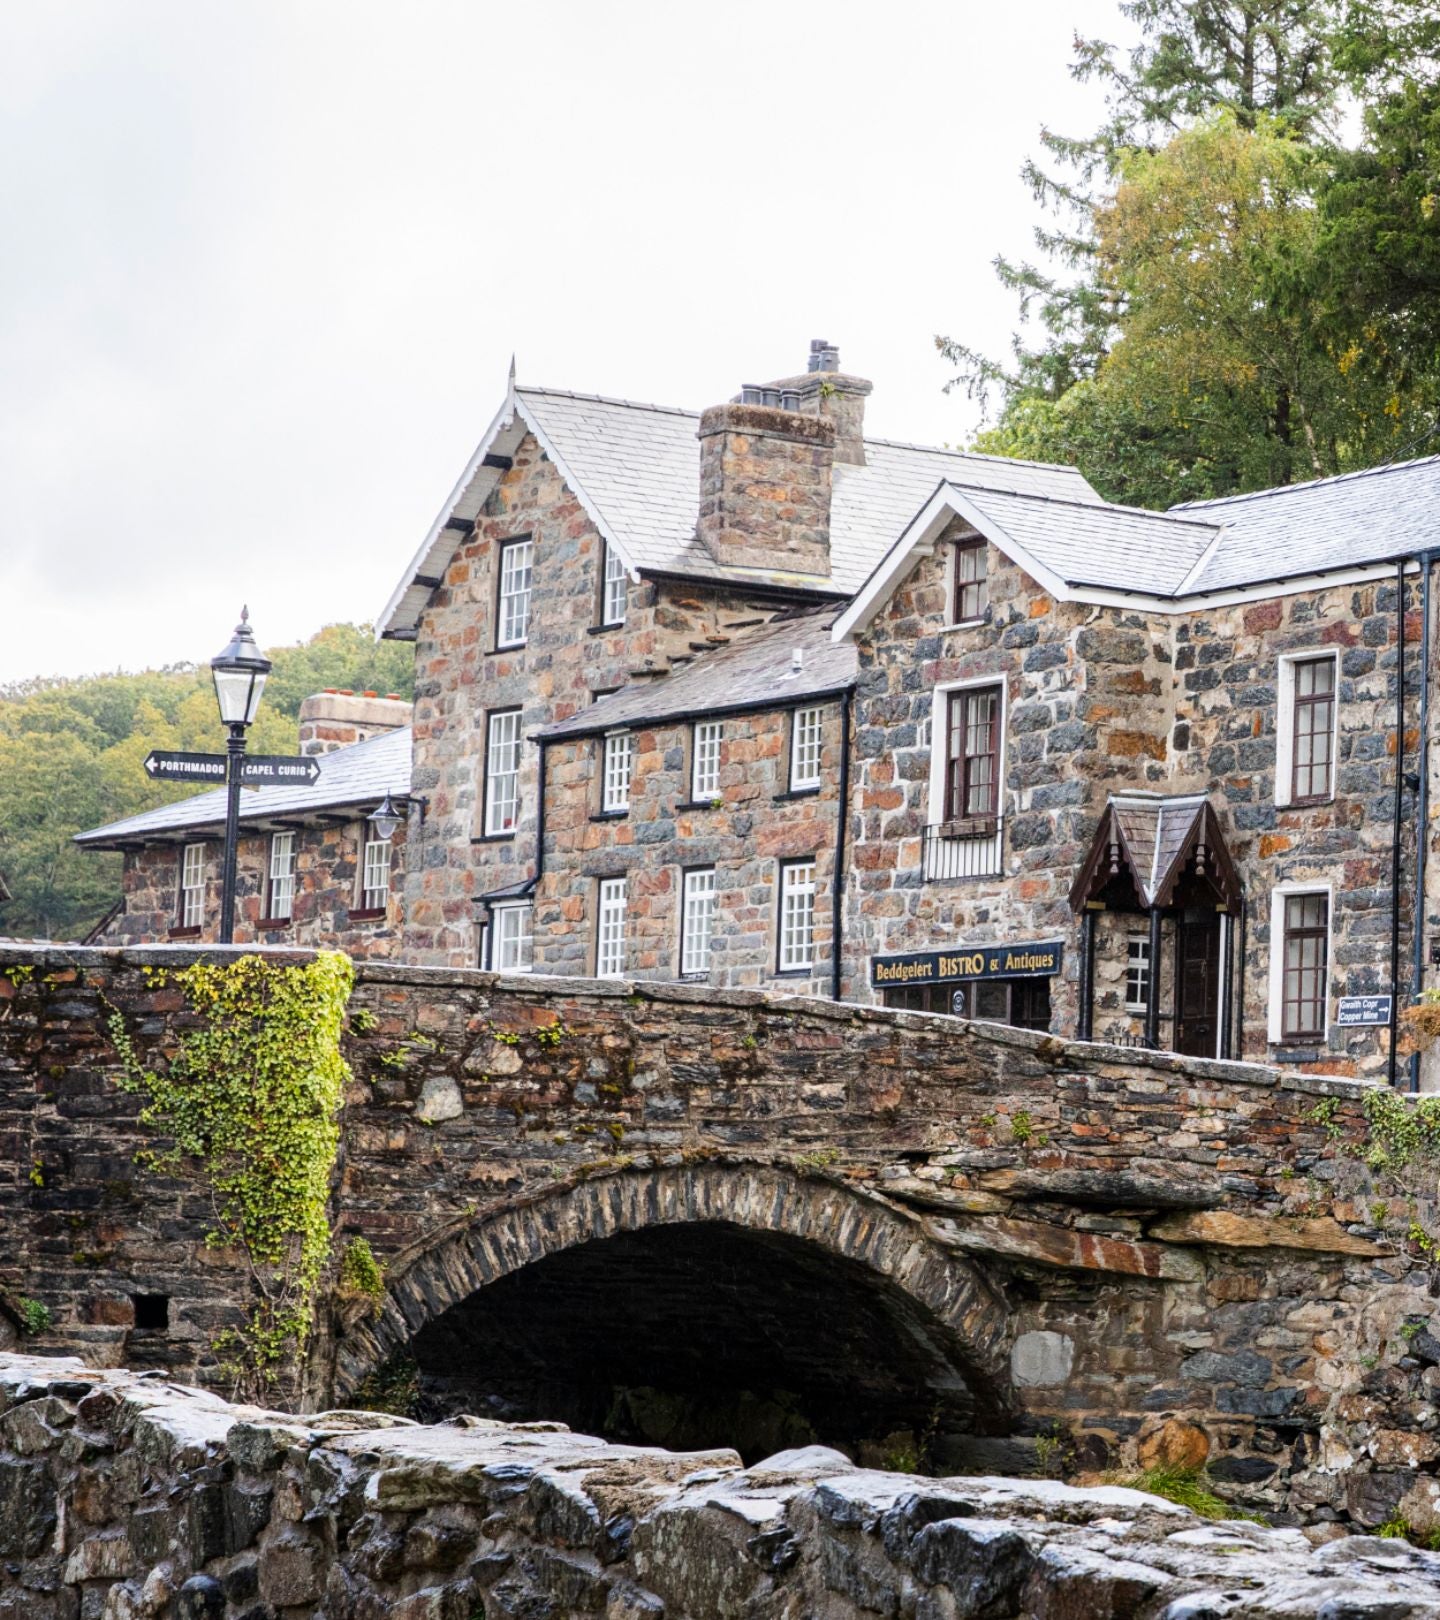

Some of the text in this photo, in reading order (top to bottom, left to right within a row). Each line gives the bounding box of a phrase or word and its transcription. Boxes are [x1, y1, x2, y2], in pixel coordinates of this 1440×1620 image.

[160, 760, 225, 775] PORTHMADOG
[246, 765, 306, 775] CAPEL CURIG
[876, 951, 1054, 981] Beddgelert BISTRO & Antiques
[1340, 1012, 1361, 1022] Copper
